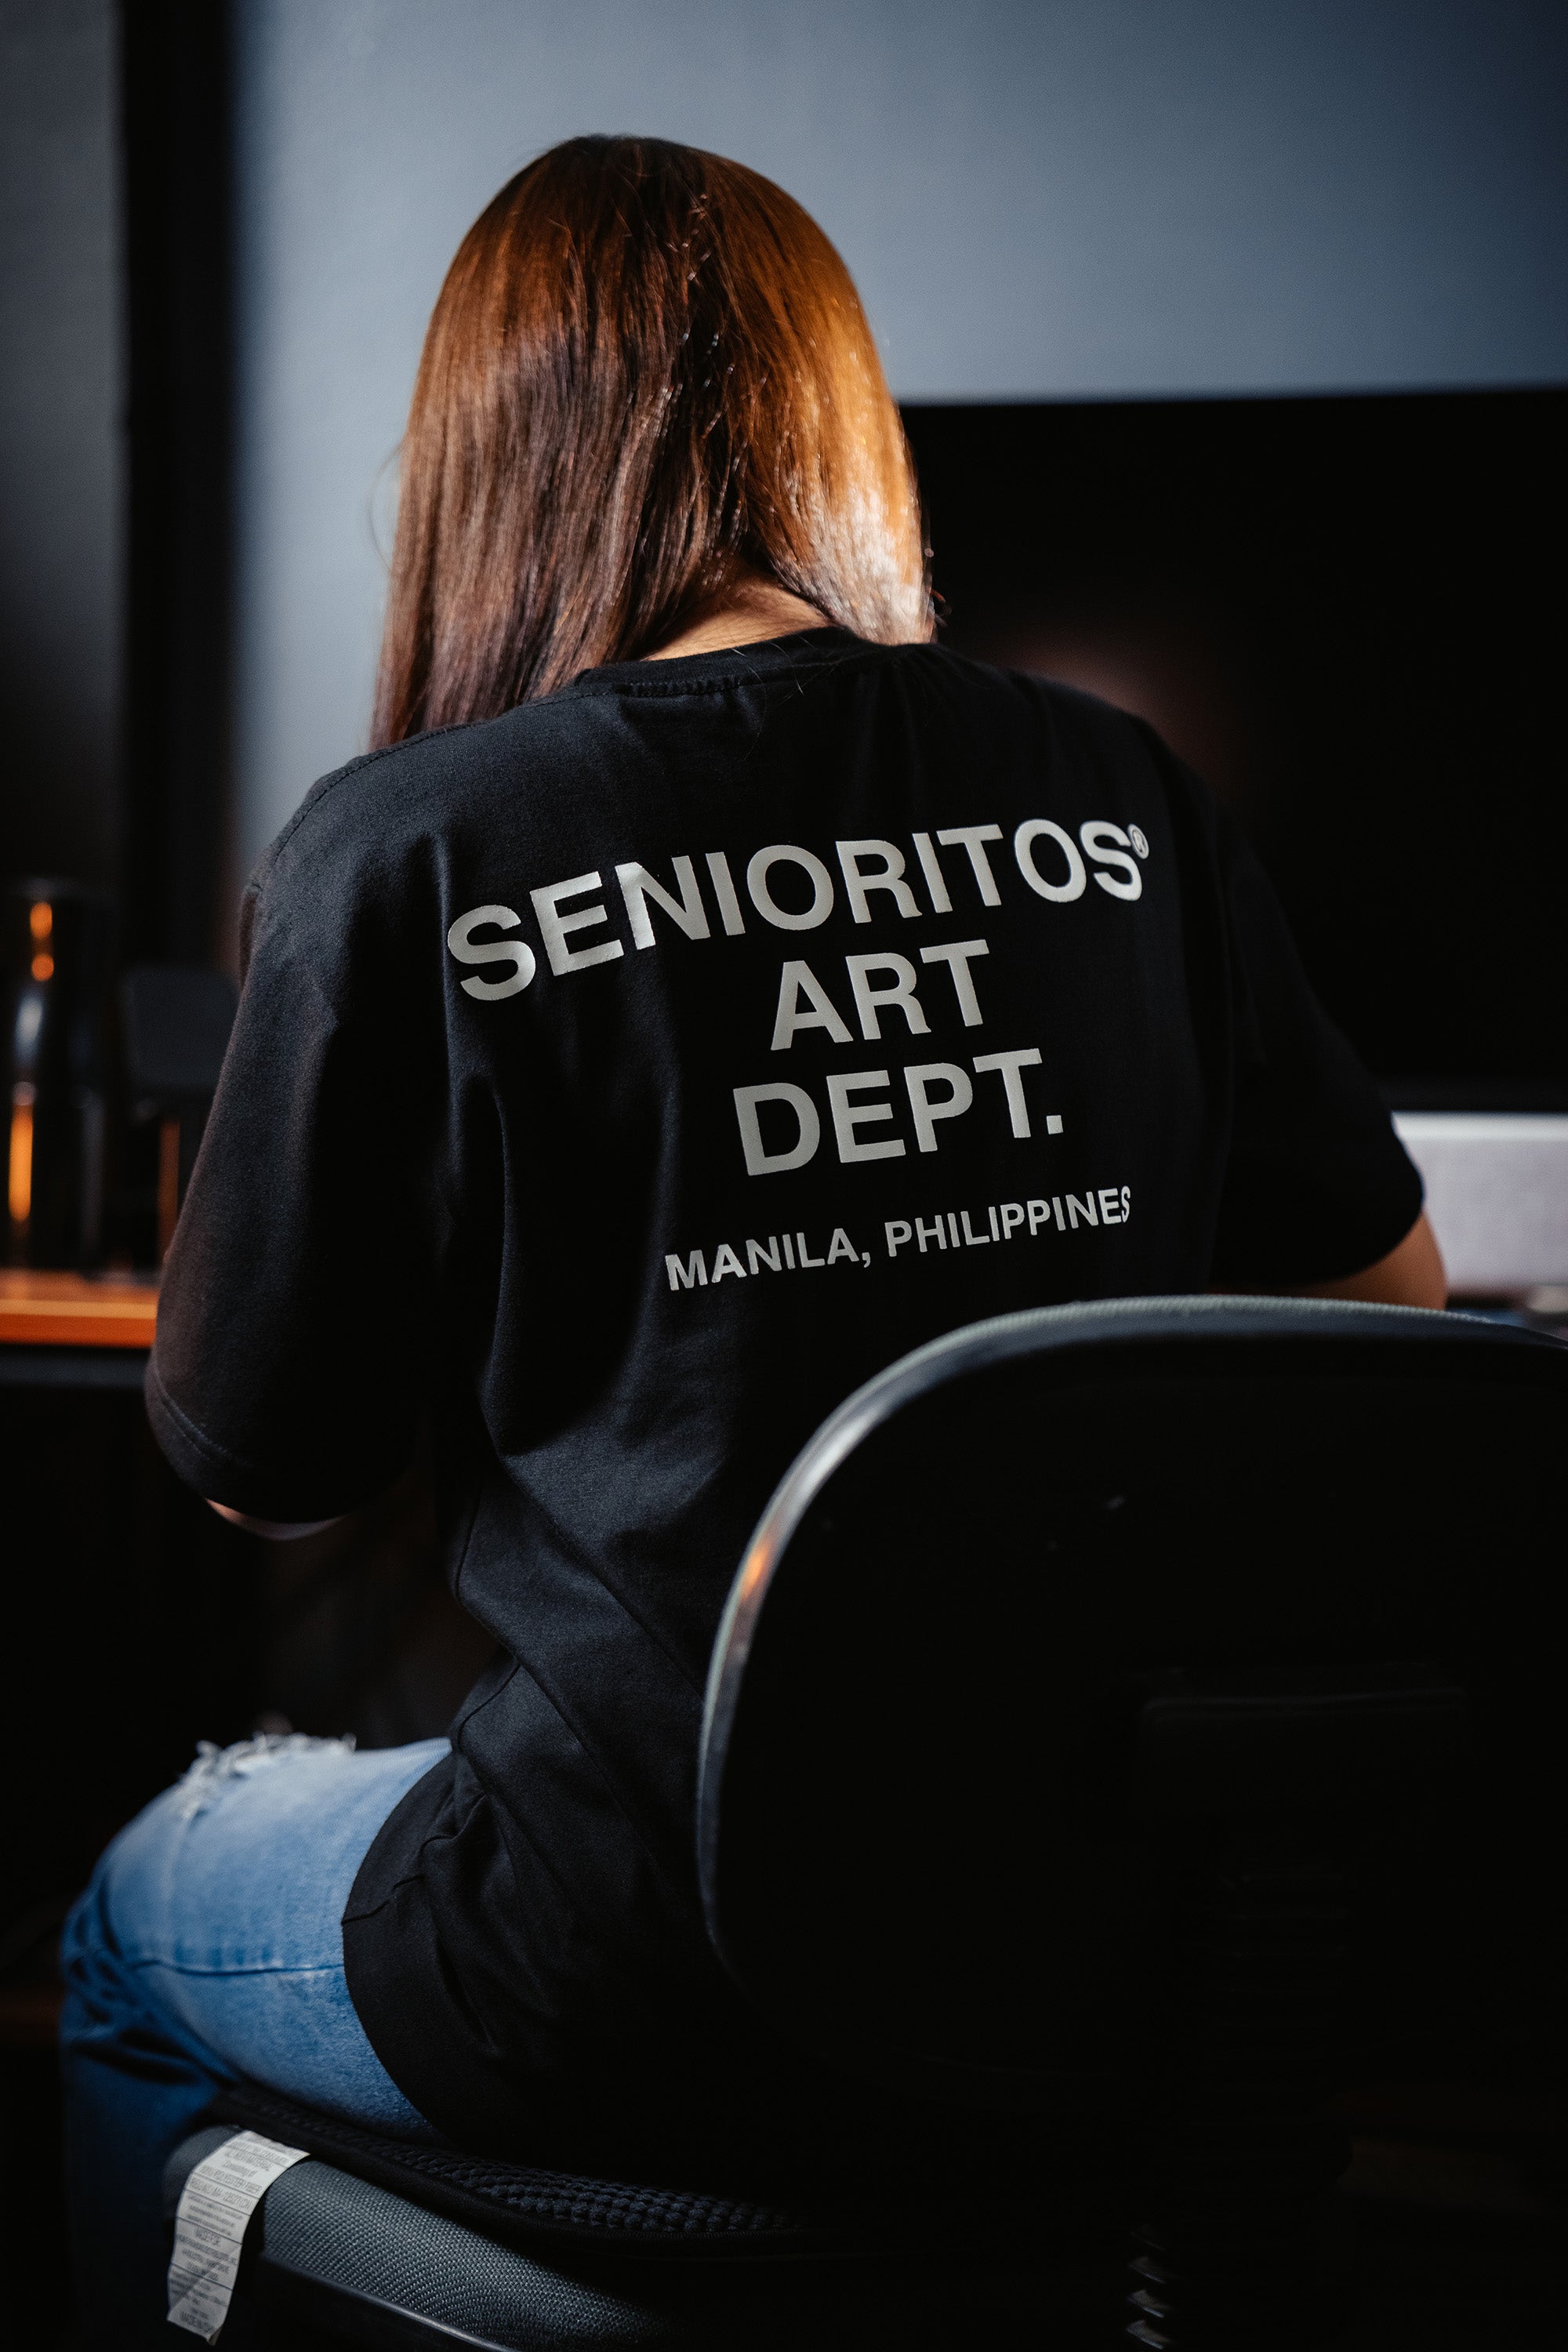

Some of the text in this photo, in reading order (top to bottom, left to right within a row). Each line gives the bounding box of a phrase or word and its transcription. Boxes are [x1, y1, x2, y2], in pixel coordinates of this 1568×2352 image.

[770, 939, 990, 1051] ART
[732, 1048, 1064, 1176] DEPT.
[664, 1185, 1131, 1291] MANILA, PHILIPPINES
